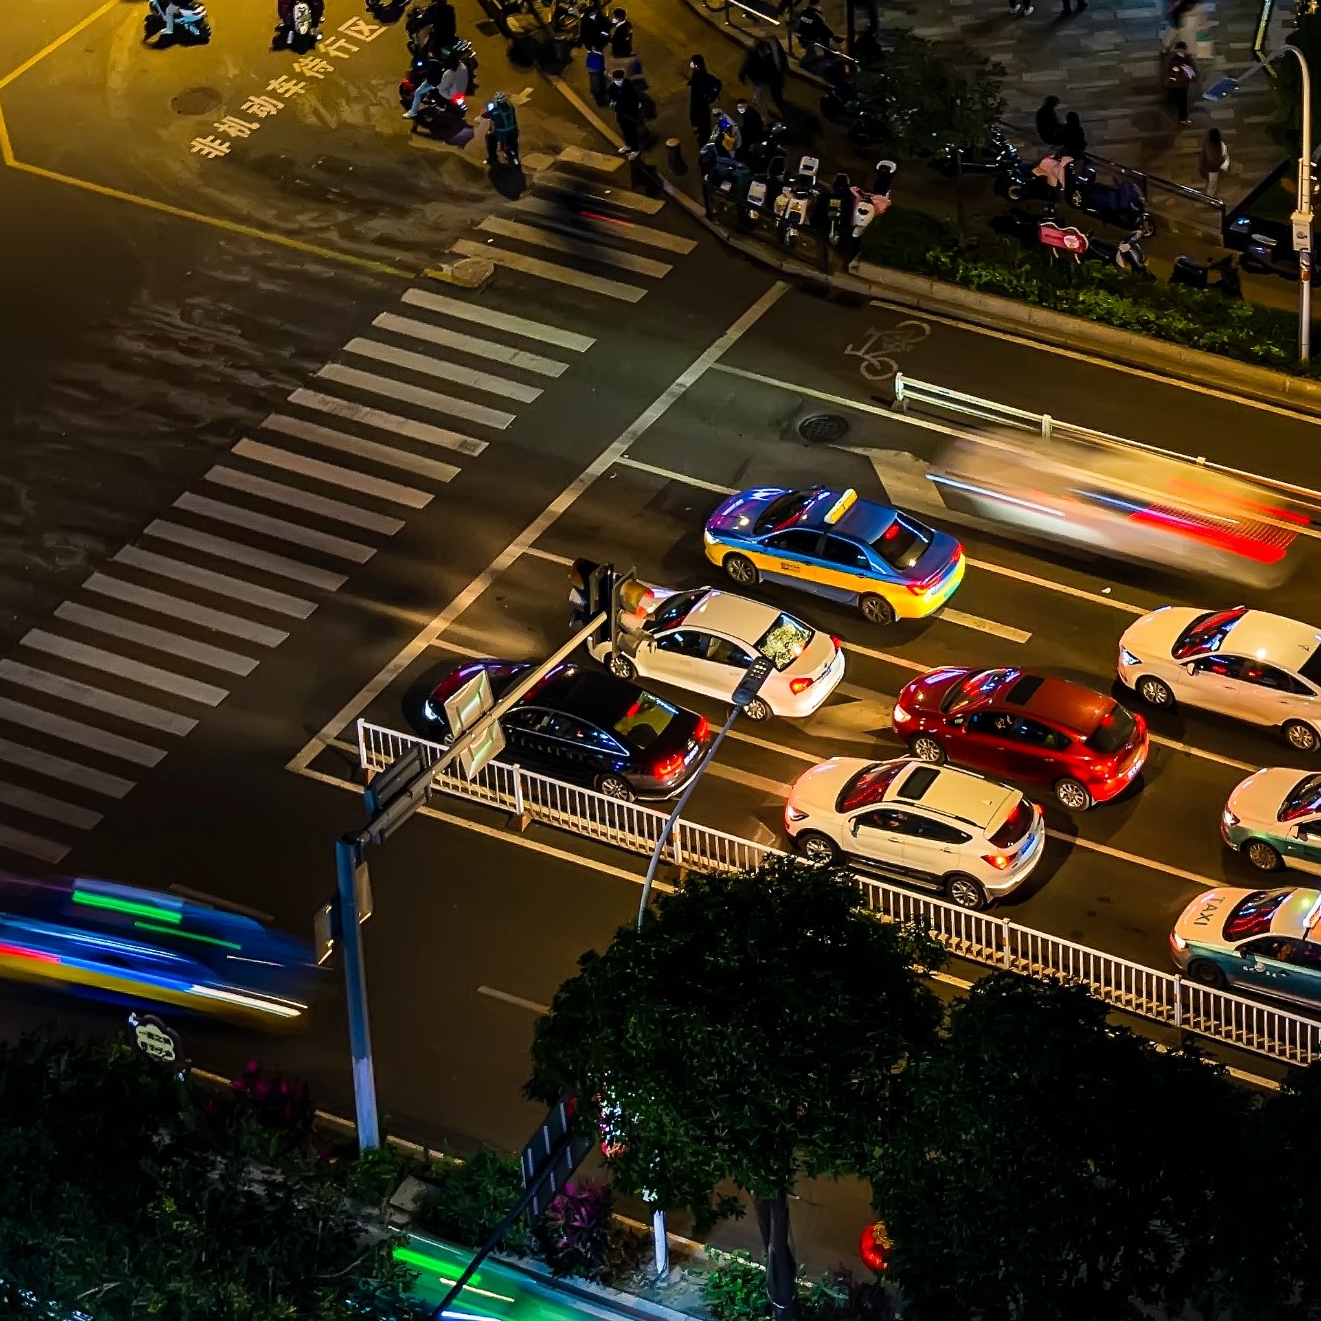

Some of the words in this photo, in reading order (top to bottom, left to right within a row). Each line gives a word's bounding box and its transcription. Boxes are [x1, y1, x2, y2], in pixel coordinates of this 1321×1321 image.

[190, 16, 389, 159] 非机动车待行区
[1193, 896, 1226, 926] TAXI
